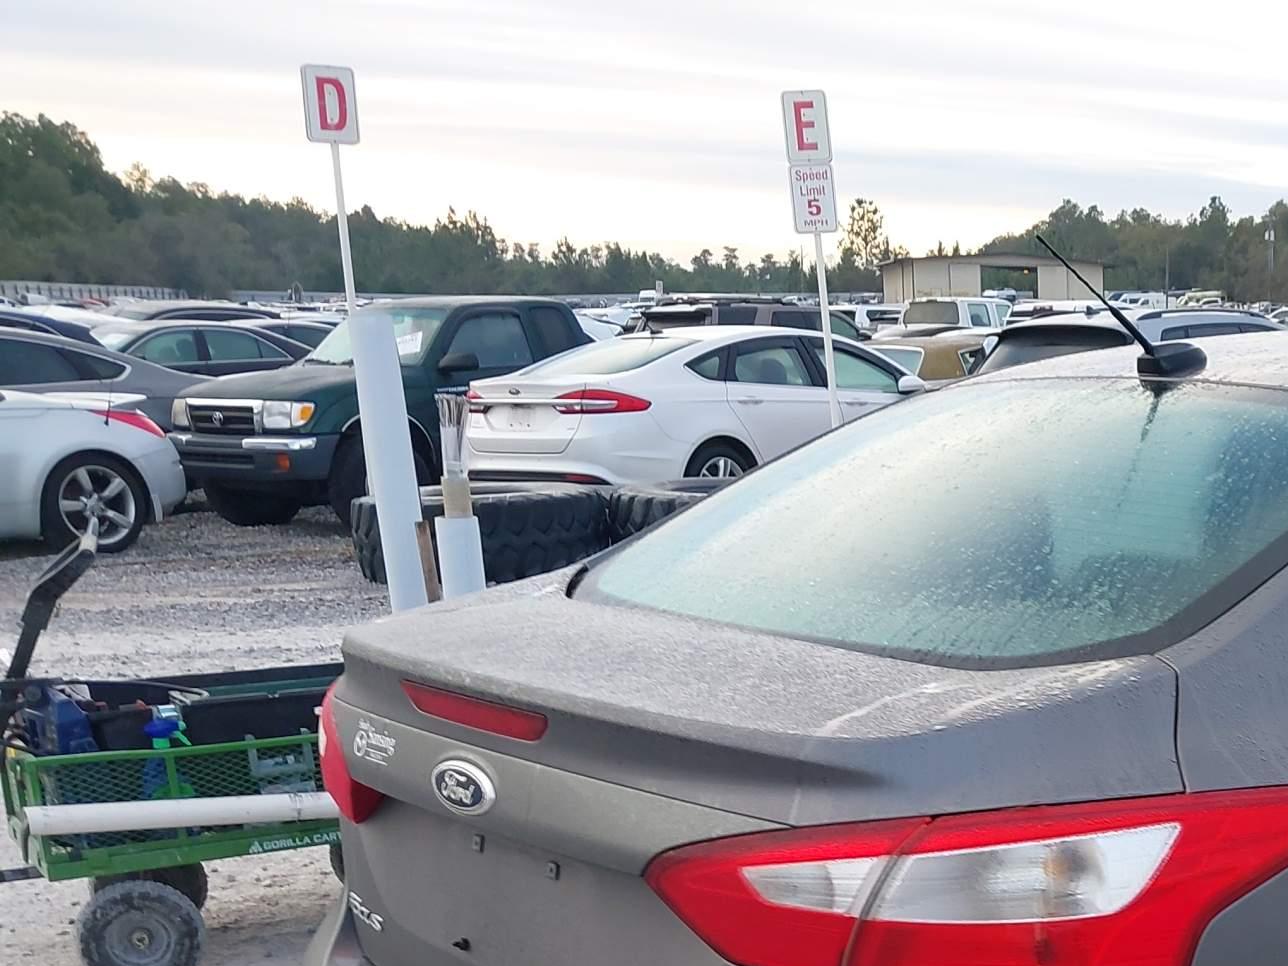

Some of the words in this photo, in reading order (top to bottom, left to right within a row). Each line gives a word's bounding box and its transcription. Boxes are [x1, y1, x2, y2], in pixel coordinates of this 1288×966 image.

[315, 76, 347, 131] D
[793, 101, 818, 151] E
[795, 169, 828, 183] Speed
[799, 184, 826, 197] Limit
[807, 199, 822, 216] 5
[804, 219, 828, 227] MPH
[441, 770, 476, 805] Ford
[263, 836, 311, 850] GORILLA
